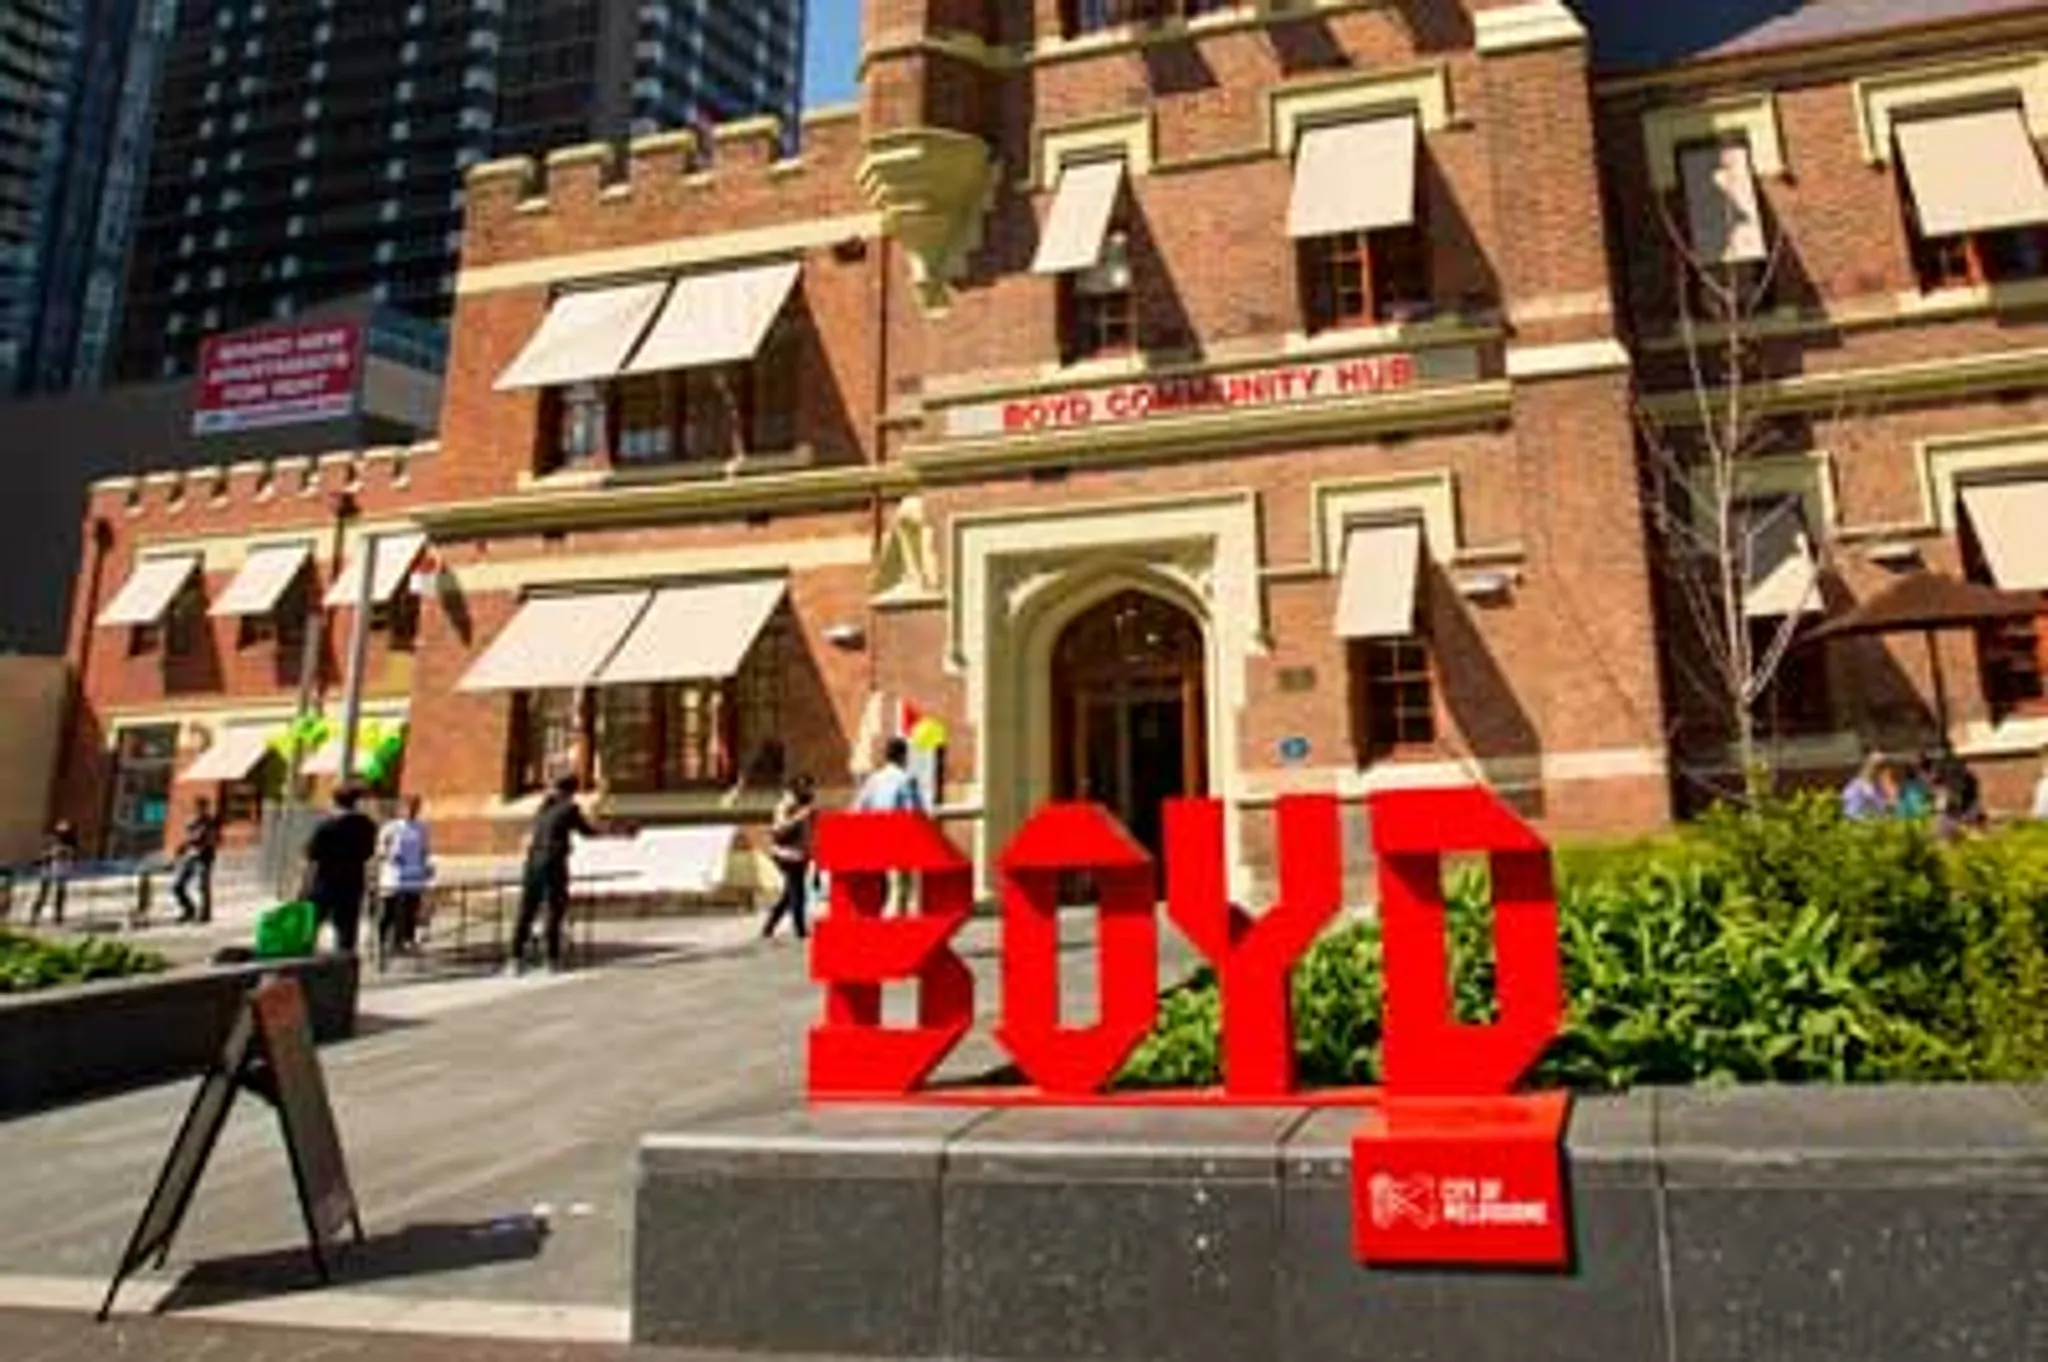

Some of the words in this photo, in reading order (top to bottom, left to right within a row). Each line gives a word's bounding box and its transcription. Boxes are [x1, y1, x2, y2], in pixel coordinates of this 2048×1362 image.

[1003, 392, 1091, 434] BOYD
[1106, 368, 1320, 418] COMMUNITY
[1337, 354, 1415, 390] HUB
[807, 787, 1564, 1096] BOYD
[1440, 1177, 1476, 1199] CITY
[1480, 1177, 1503, 1200] OF
